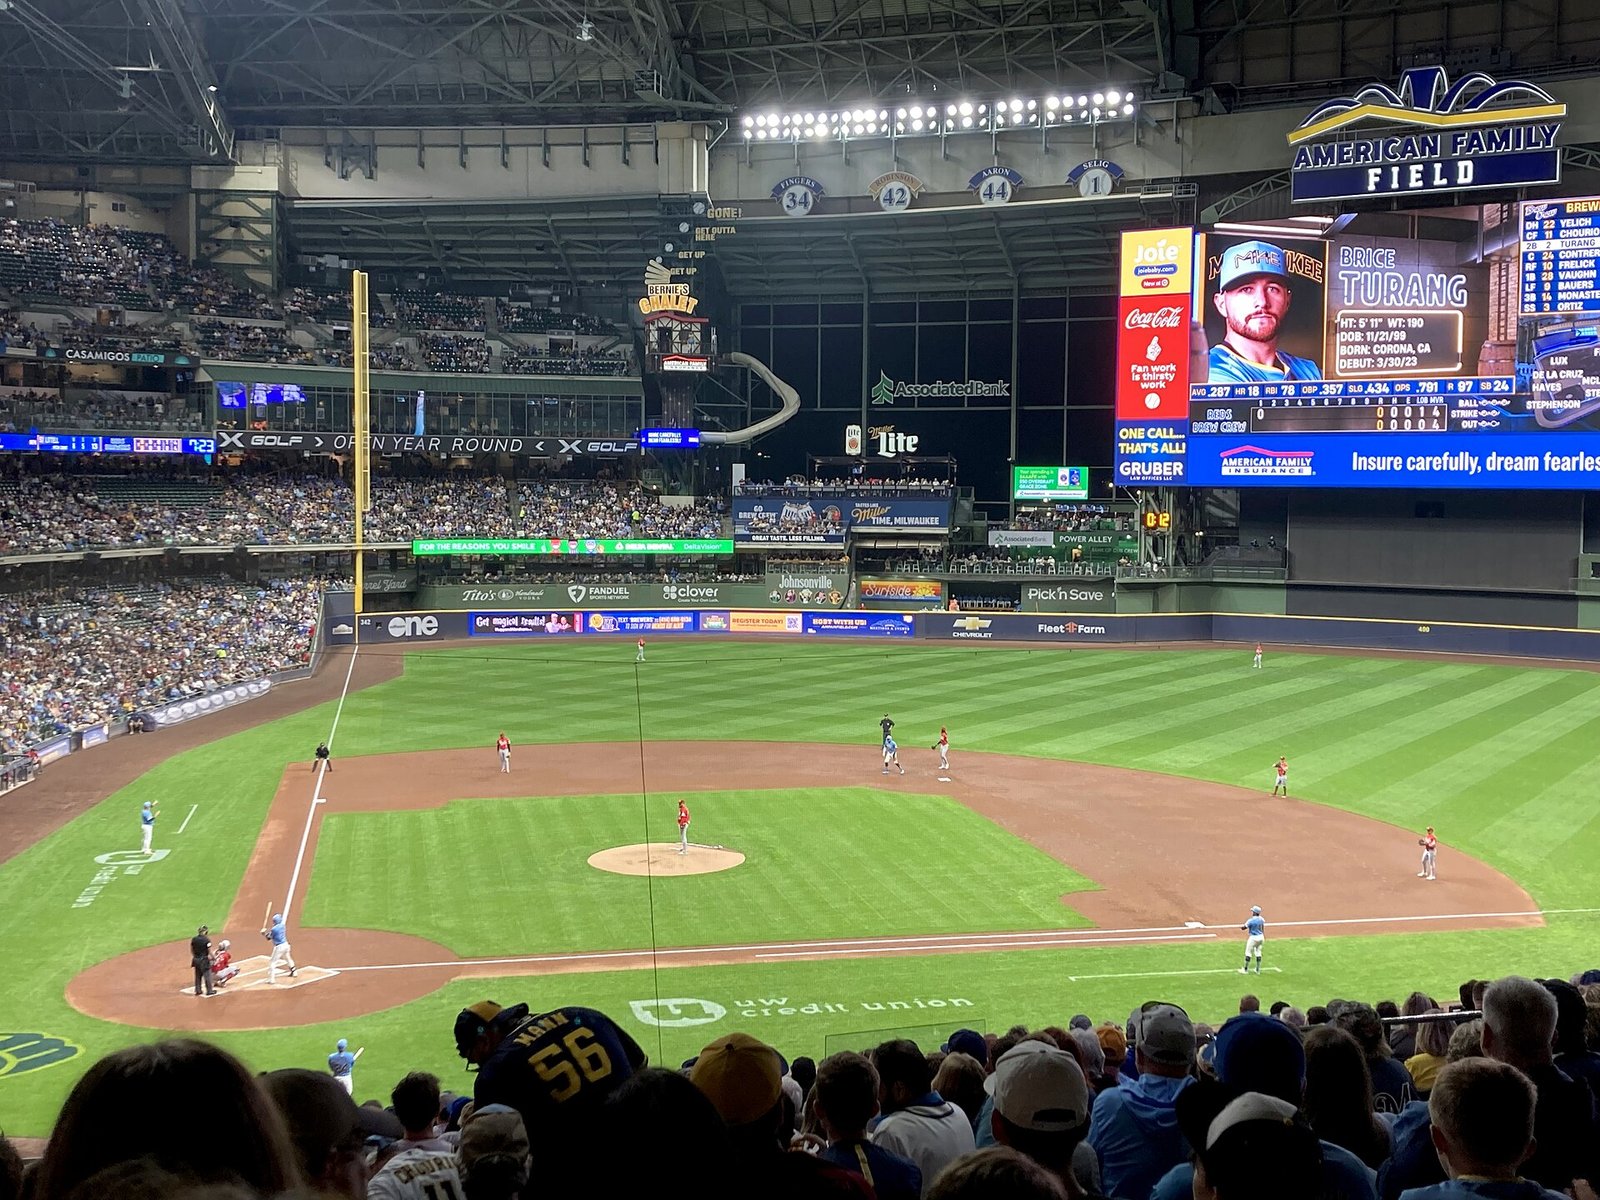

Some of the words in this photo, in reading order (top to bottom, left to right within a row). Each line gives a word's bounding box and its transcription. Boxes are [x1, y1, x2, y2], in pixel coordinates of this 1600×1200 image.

[1294, 134, 1441, 170] AMERICAN
[1452, 123, 1561, 155] FAMILY
[1082, 160, 1109, 169] SELIG
[982, 168, 1010, 177] AARON
[1367, 160, 1474, 192] FIELD
[781, 177, 815, 189] FINGERS
[1091, 177, 1101, 195] 1
[883, 188, 907, 206] 42
[983, 182, 1008, 200] 44
[785, 191, 810, 210] 34
[707, 208, 742, 218] GONE!
[1560, 218, 1591, 228] YELICH
[712, 226, 736, 234] OUTTA
[1560, 228, 1600, 238] CHOURIO
[1560, 239, 1595, 248] TURANG
[1134, 239, 1179, 263] Joie
[1340, 246, 1396, 268] BRICE
[1137, 266, 1174, 275] joiebaby.com
[1559, 260, 1595, 269] FRELICK
[1559, 270, 1597, 280] VAUGHN
[649, 284, 689, 295] BERNIE'S
[1338, 271, 1468, 307] TURANG
[1558, 280, 1594, 290] BAUERS
[639, 295, 698, 314] CHALET
[1558, 302, 1583, 311] ORTIZ
[1125, 307, 1184, 329] Coca-Cola
[1340, 319, 1356, 328] HT:
[1388, 318, 1405, 328] WT:
[1407, 318, 1424, 328] 190
[1340, 331, 1364, 341] DOB:
[1366, 331, 1406, 341] 11/21/99
[1340, 345, 1371, 355] BORN:
[1373, 344, 1415, 354] CORONA,
[1417, 343, 1431, 353] CA
[66, 349, 130, 362] CASAMIGOS
[137, 354, 160, 362] PATIO
[1550, 357, 1568, 365] LUX
[1131, 364, 1149, 373] Fan
[1151, 363, 1176, 372] work
[1340, 359, 1375, 369] DEBUT:
[1377, 357, 1417, 368] 3/30/23
[1132, 372, 1140, 381] is
[1142, 372, 1175, 382] thirsty
[1532, 370, 1544, 379] DE
[1546, 370, 1558, 378] LA
[1560, 370, 1584, 378] CRUZ
[1140, 380, 1166, 389] work
[1191, 388, 1206, 396] AVG
[1207, 387, 1230, 397] .287
[1248, 386, 1259, 396] 18
[1281, 385, 1295, 395] 78
[1319, 384, 1344, 395] .357
[1349, 385, 1363, 393] SLG
[1365, 383, 1390, 394] .434
[1416, 382, 1438, 393] .791
[1458, 381, 1474, 392] 97
[1493, 380, 1509, 391] 24
[1532, 383, 1561, 391] HAYES
[1459, 400, 1478, 408] BALL
[1526, 400, 1580, 409] STEPHENSON
[1451, 409, 1478, 418] STRIKE
[1462, 420, 1478, 428] OUT
[1119, 428, 1145, 439] ONE
[188, 439, 214, 452] 7:23
[250, 435, 303, 447] GOLF
[392, 437, 440, 451] YEAR
[452, 438, 524, 452] ROUND
[587, 441, 638, 452] GOLF
[877, 431, 919, 458] Lite
[1118, 443, 1159, 454] THAT'S
[1160, 442, 1186, 454] ALL!
[1222, 457, 1273, 467] AMERICAN
[1276, 457, 1312, 467] FAMILY
[1352, 451, 1402, 471] Insure
[1406, 451, 1481, 475] carefully,
[1486, 451, 1539, 471] dream
[1120, 462, 1183, 476] GRUBER
[851, 506, 891, 523] Miller
[1146, 513, 1170, 528] 0:12
[871, 517, 892, 525] TIME,
[894, 517, 940, 525] MILWAUKEE
[779, 575, 832, 589] Johnsonville
[462, 589, 496, 601] Tito's
[589, 587, 630, 595] FANDUEL
[678, 585, 718, 597] clover
[865, 583, 912, 597] Surfside
[1069, 588, 1103, 601] Save
[388, 615, 438, 637] one
[476, 616, 489, 627] Get
[493, 616, 518, 628] magical
[1038, 624, 1065, 633] Fleet
[1077, 624, 1105, 634] Farm
[734, 997, 789, 1008] uw
[741, 1003, 849, 1017] credit
[861, 997, 975, 1010] union
[513, 1012, 569, 1048] MANN
[528, 1026, 612, 1103] 56
[393, 1155, 458, 1184] CHOURI
